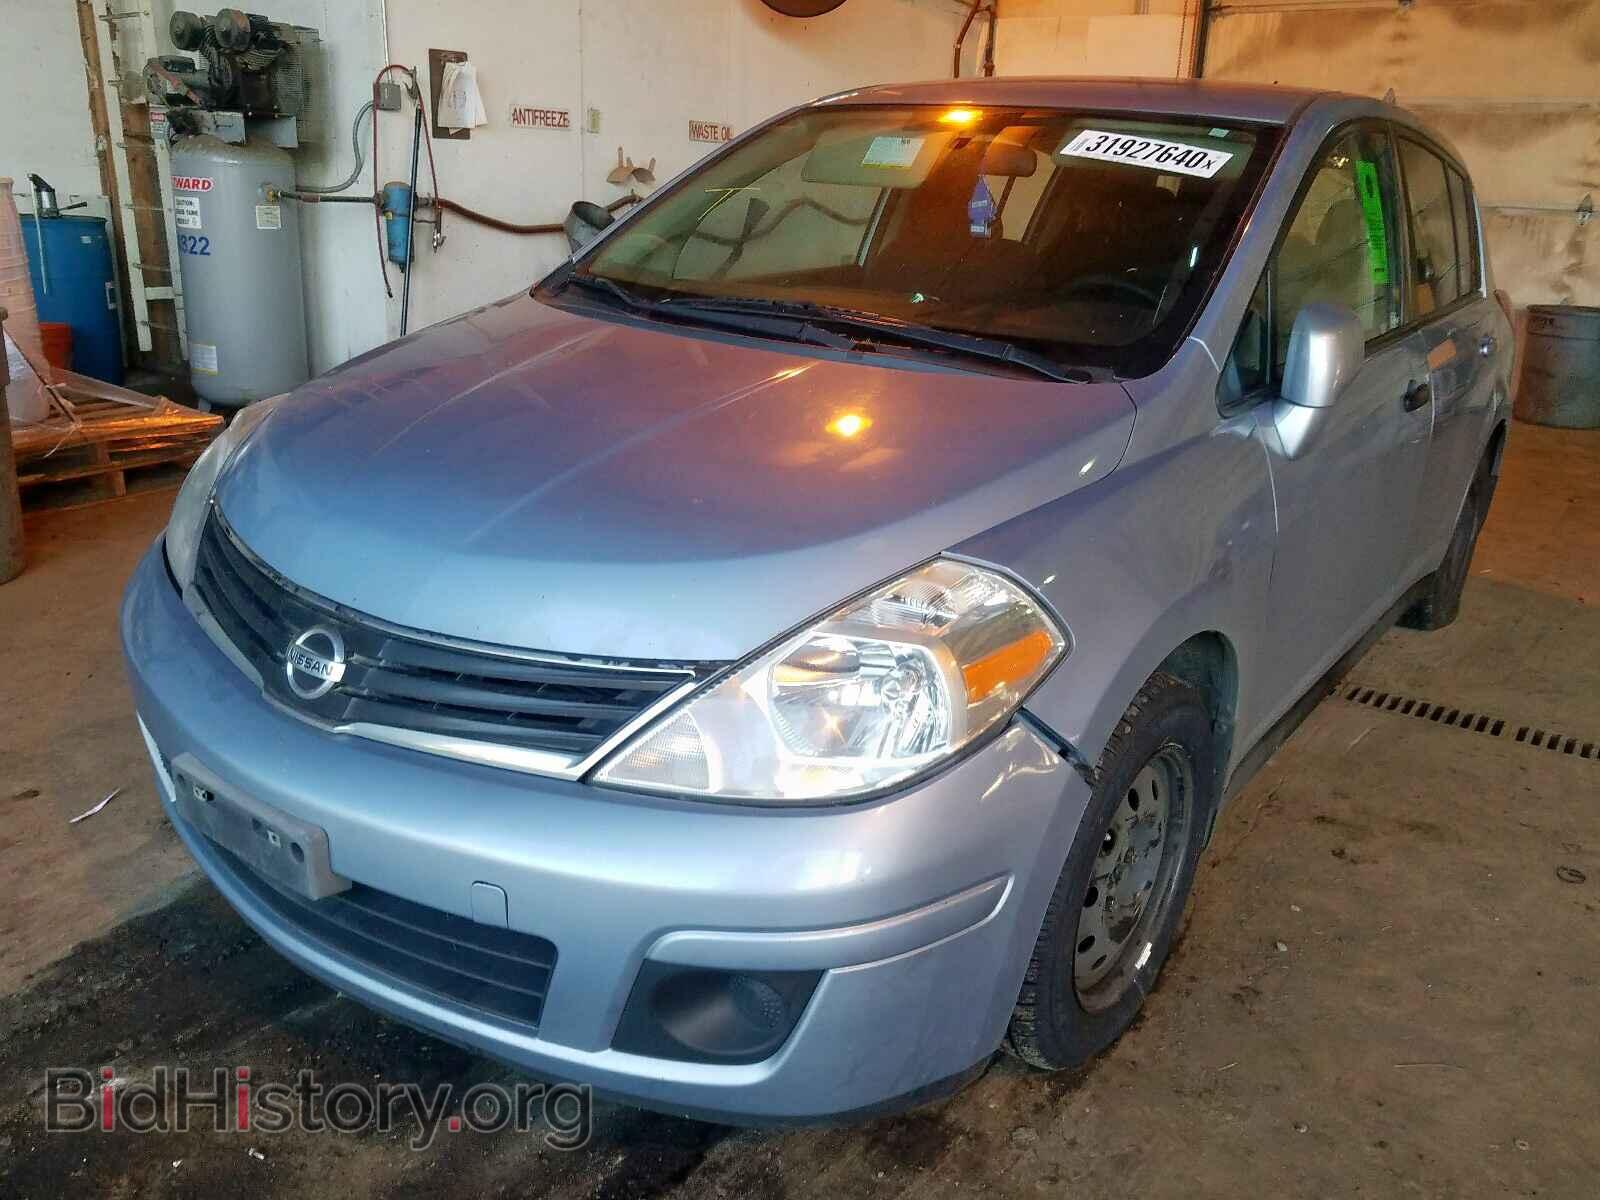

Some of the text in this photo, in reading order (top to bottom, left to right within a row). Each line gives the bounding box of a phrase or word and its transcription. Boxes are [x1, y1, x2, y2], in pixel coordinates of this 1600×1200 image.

[512, 107, 570, 128] ANTIFREEZE
[691, 123, 718, 140] WASTE
[288, 646, 334, 677] NISSAN
